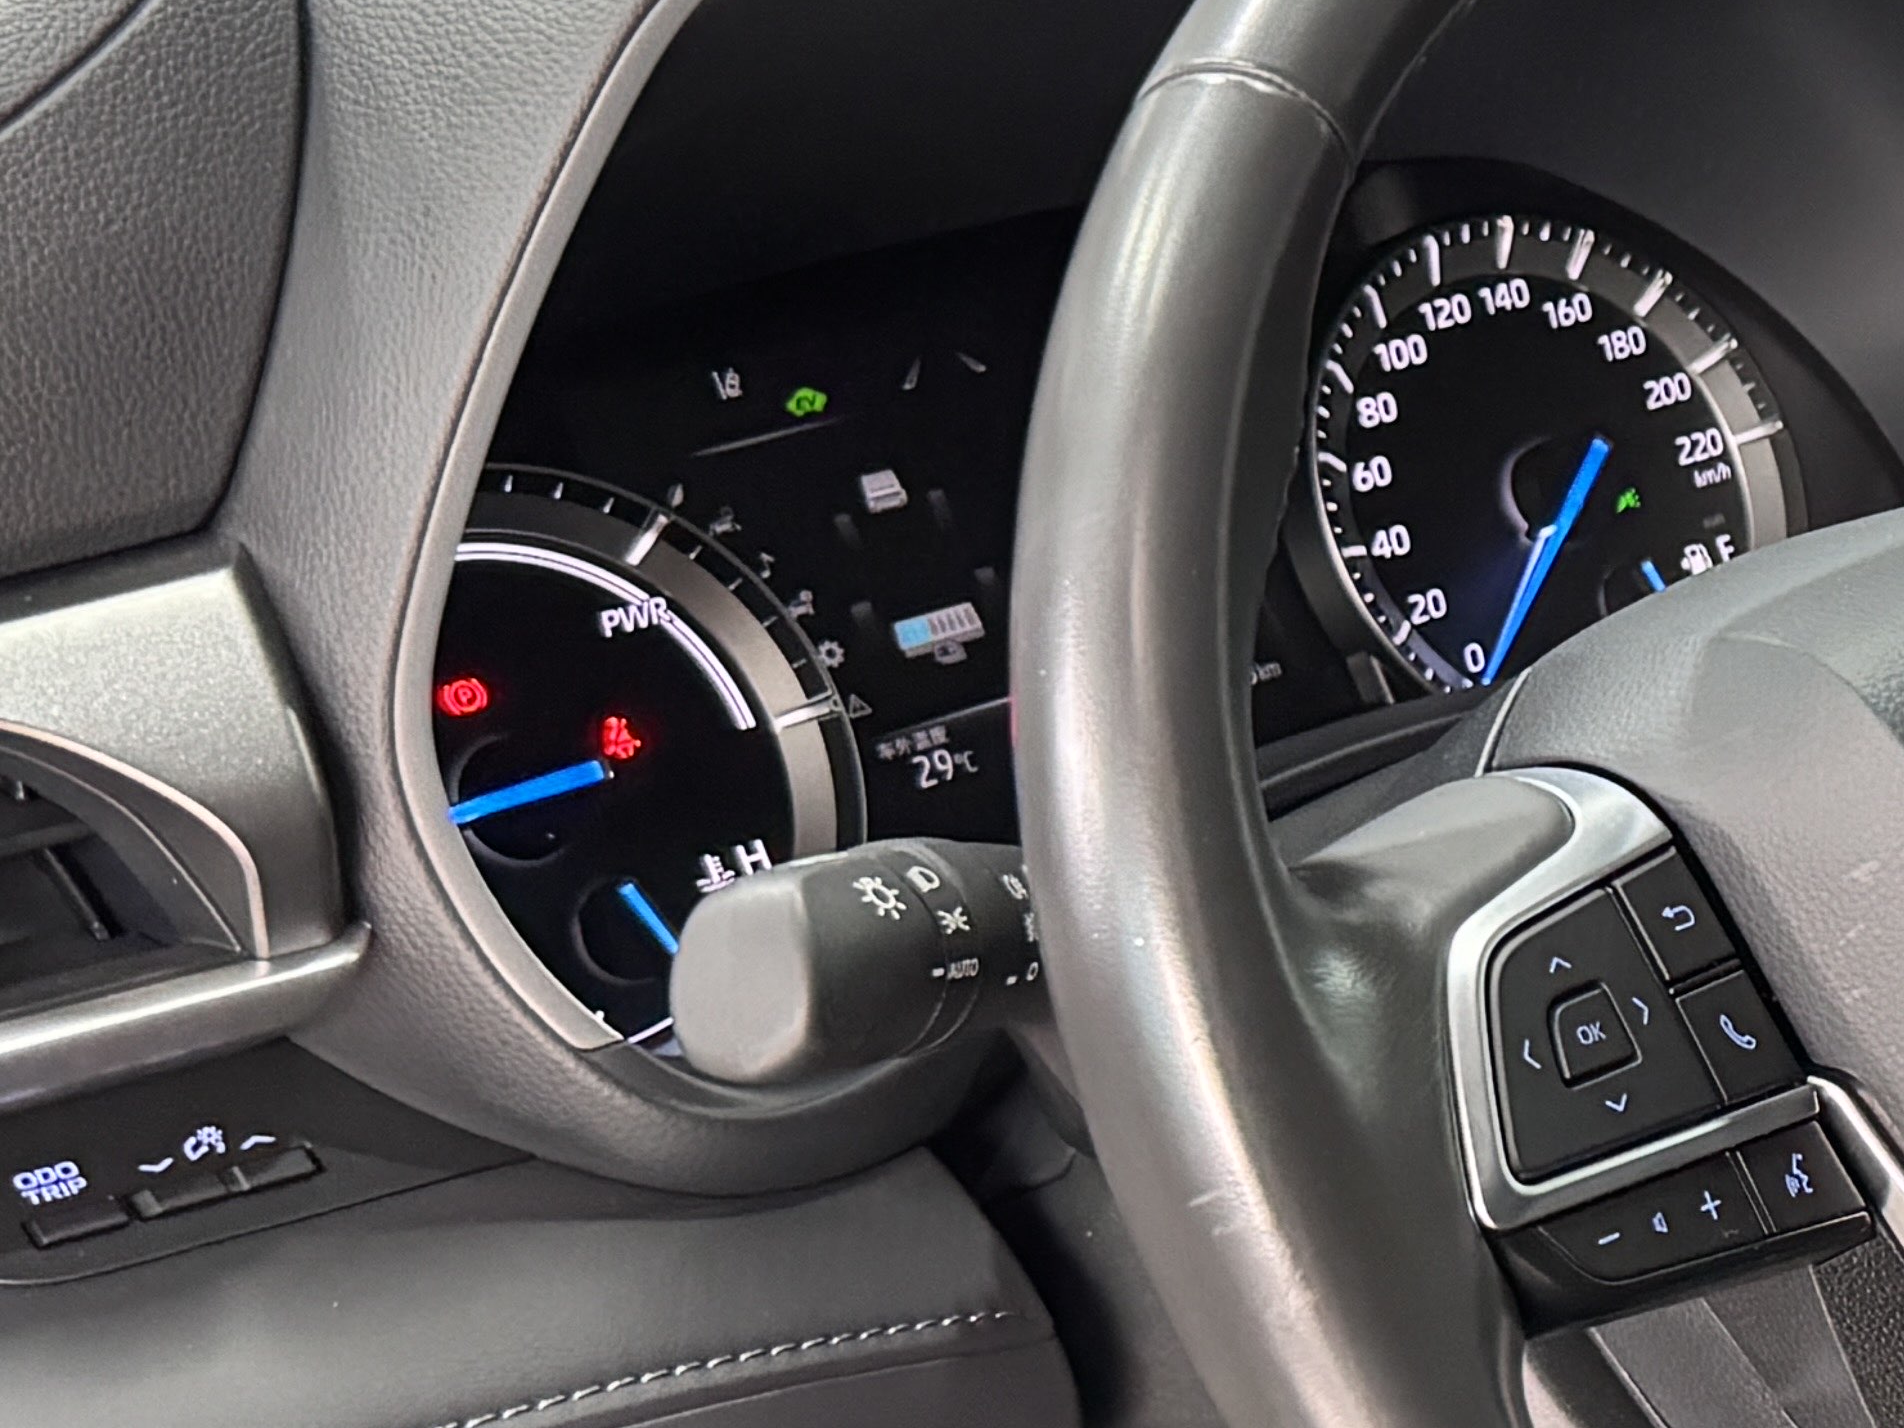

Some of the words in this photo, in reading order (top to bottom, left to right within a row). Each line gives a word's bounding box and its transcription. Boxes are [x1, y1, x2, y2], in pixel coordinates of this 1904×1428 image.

[1418, 293, 1472, 332] 120
[1478, 278, 1531, 315] 140
[1542, 292, 1593, 329] 160
[1373, 333, 1428, 372] 100
[1598, 325, 1647, 362] 180
[1356, 391, 1398, 429] 80
[1643, 371, 1693, 412] 200
[1675, 428, 1724, 466] 220
[1352, 454, 1392, 493] 60
[1371, 524, 1411, 559] 40
[1715, 534, 1735, 562] F
[600, 597, 671, 638] PWR
[1408, 588, 1448, 625] 20
[1463, 642, 1486, 674] 0
[736, 838, 773, 875] H
[947, 957, 980, 980] AUTO
[1576, 1021, 1607, 1045] OK
[12, 1160, 80, 1191] ODO
[20, 1176, 87, 1206] TRIP
